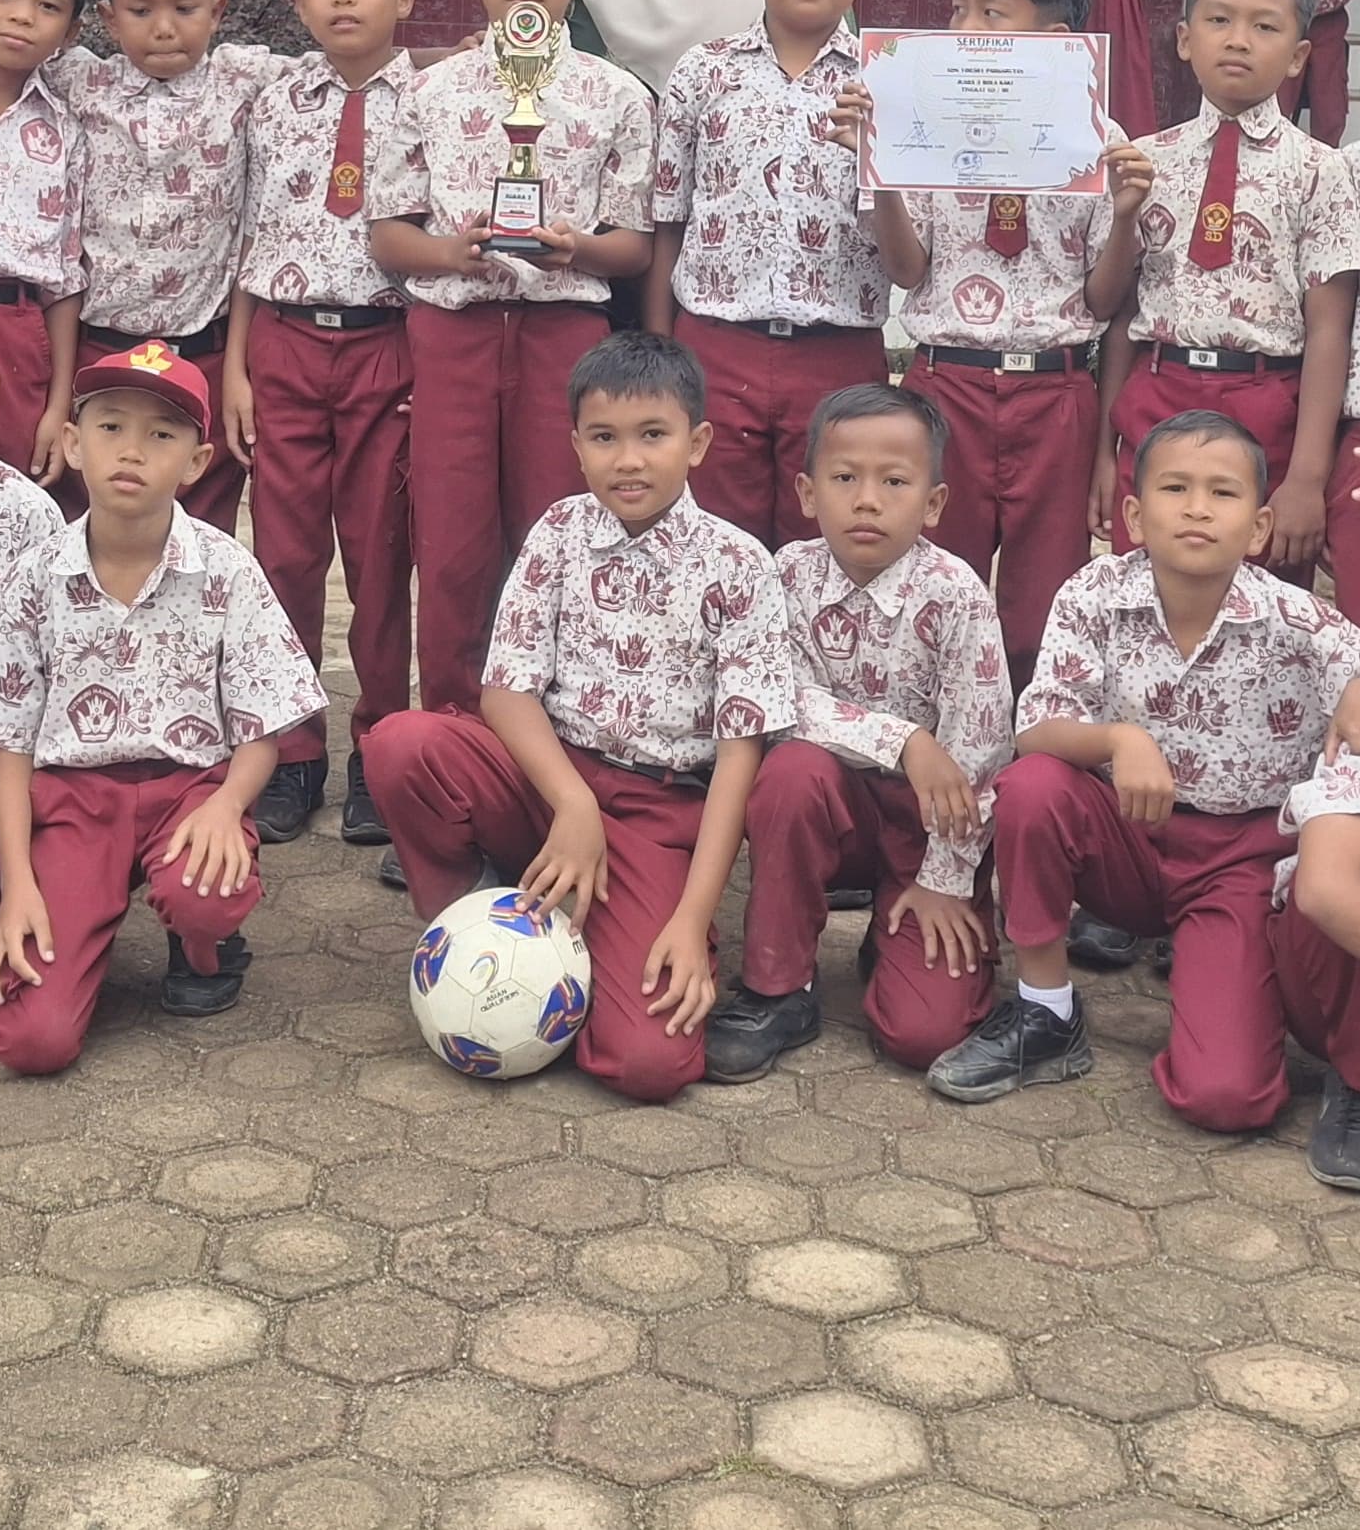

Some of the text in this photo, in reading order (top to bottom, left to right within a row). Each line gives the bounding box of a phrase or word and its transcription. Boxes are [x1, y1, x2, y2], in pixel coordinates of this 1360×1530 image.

[337, 186, 356, 198] SD
[999, 220, 1017, 231] SD
[1204, 230, 1222, 243] SD
